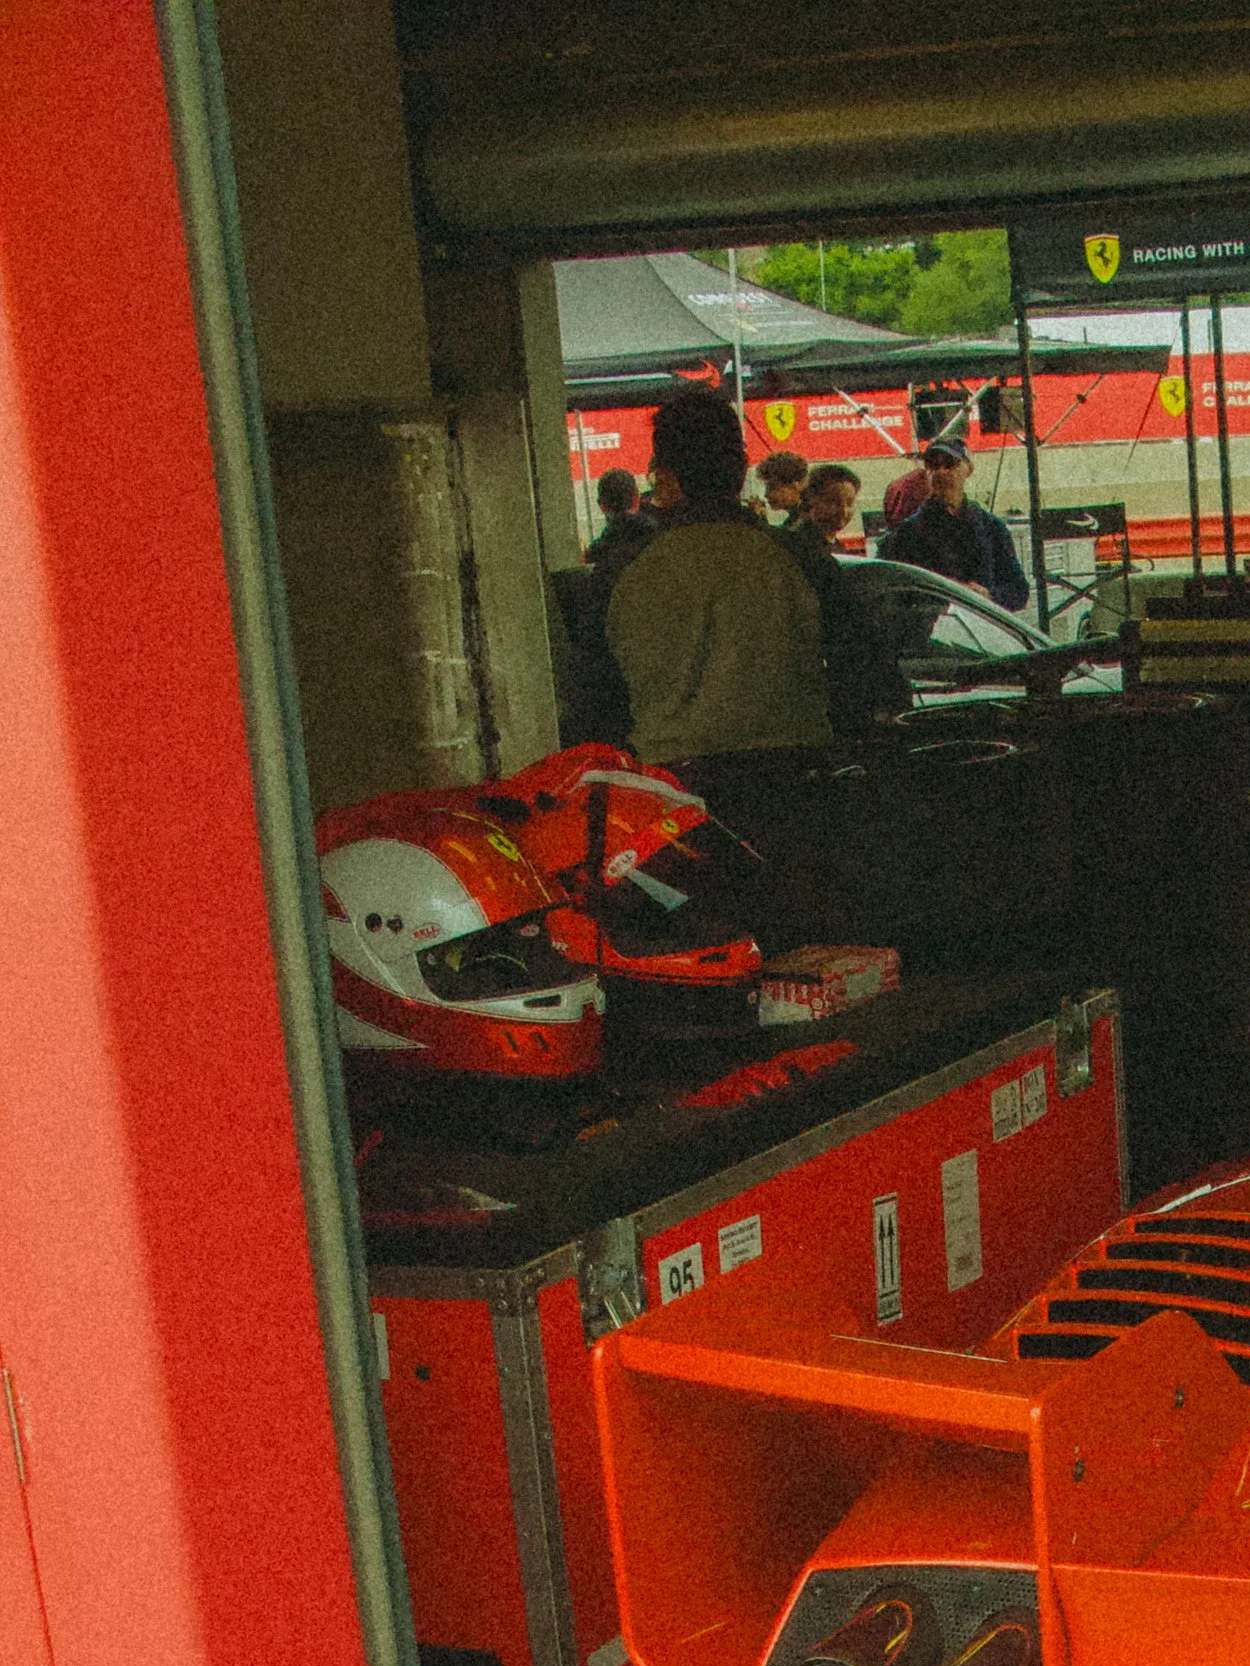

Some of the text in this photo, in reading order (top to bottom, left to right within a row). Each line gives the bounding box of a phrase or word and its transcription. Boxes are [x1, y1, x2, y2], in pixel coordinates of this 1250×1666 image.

[1133, 244, 1197, 264] RACING
[1202, 240, 1245, 257] WITH
[809, 415, 904, 431] CHALLEGE
[669, 1259, 695, 1297] 95
